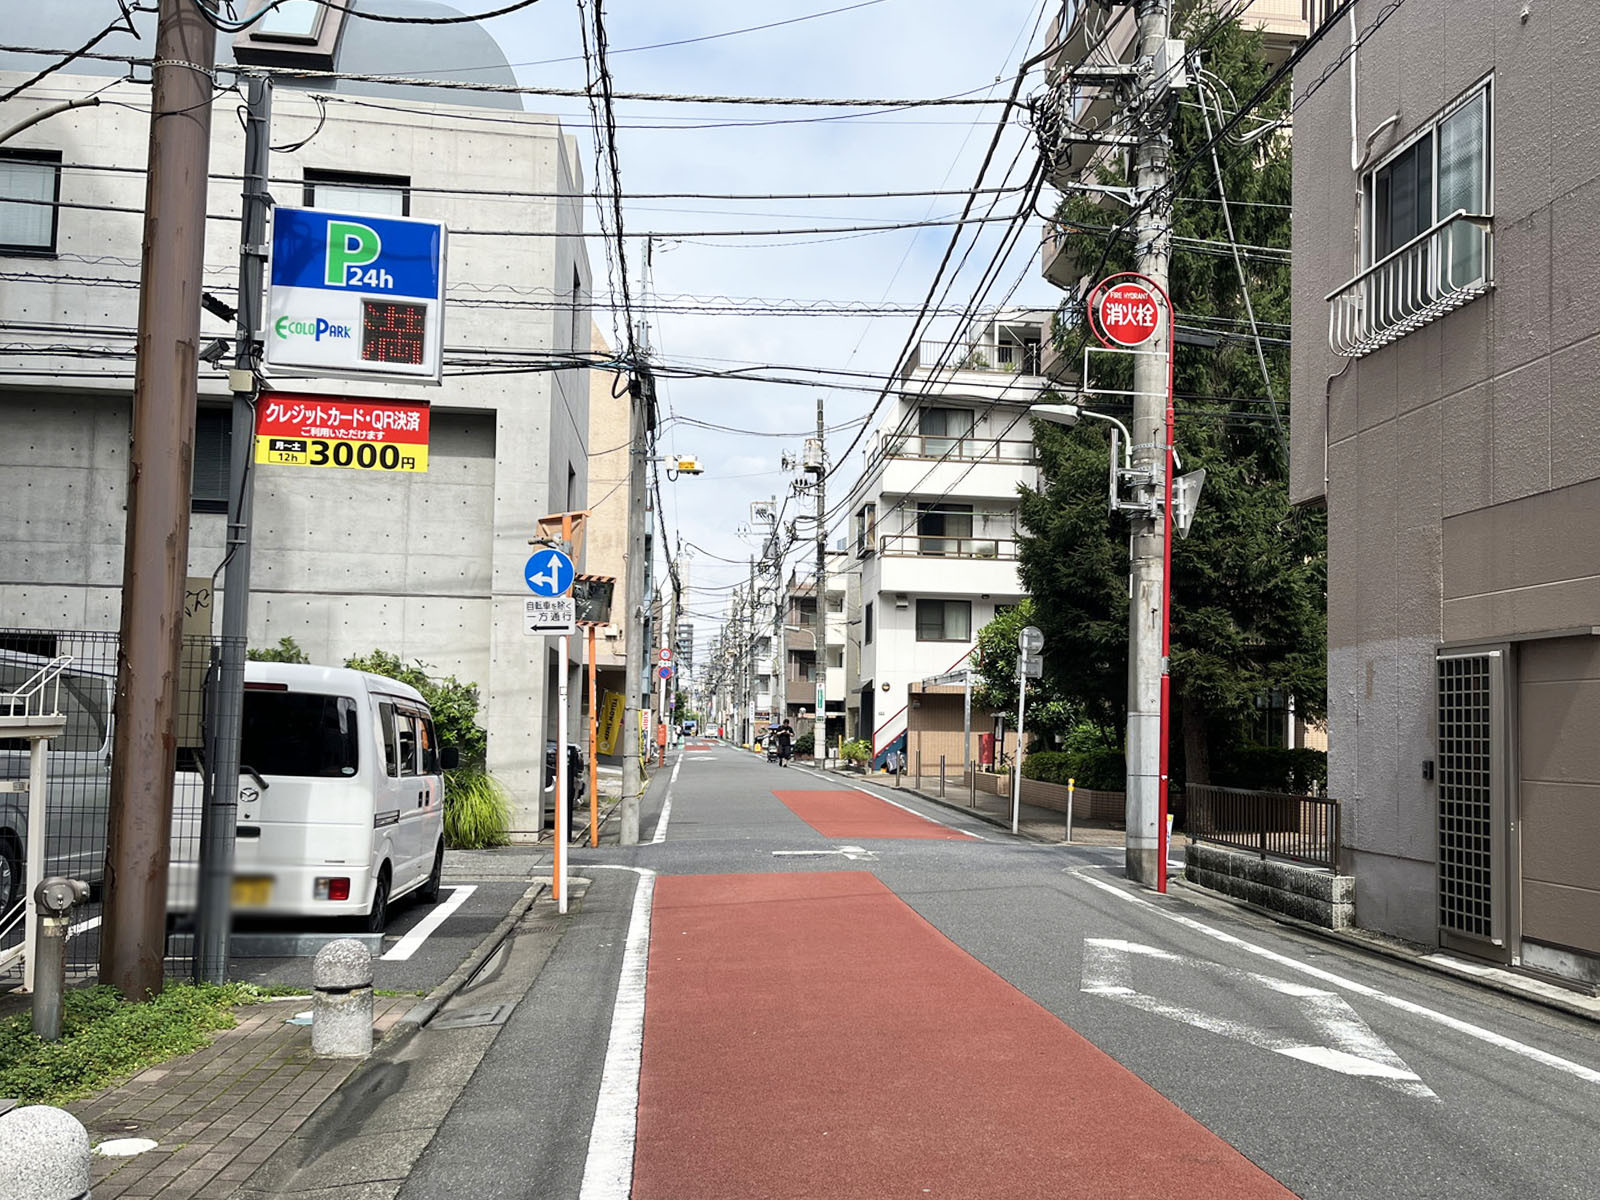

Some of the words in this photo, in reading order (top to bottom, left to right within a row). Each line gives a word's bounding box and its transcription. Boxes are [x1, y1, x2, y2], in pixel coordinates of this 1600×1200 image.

[324, 219, 382, 287] P
[348, 267, 394, 289] 24h
[1105, 302, 1155, 327] 消火栓
[265, 402, 421, 432] クレジットカード・QR決済
[300, 426, 386, 441] ご利用いただけます
[278, 452, 298, 463] 12h
[309, 440, 416, 471] 3000円
[526, 600, 573, 611] 自転車を除く
[526, 612, 573, 622] 一方通行
